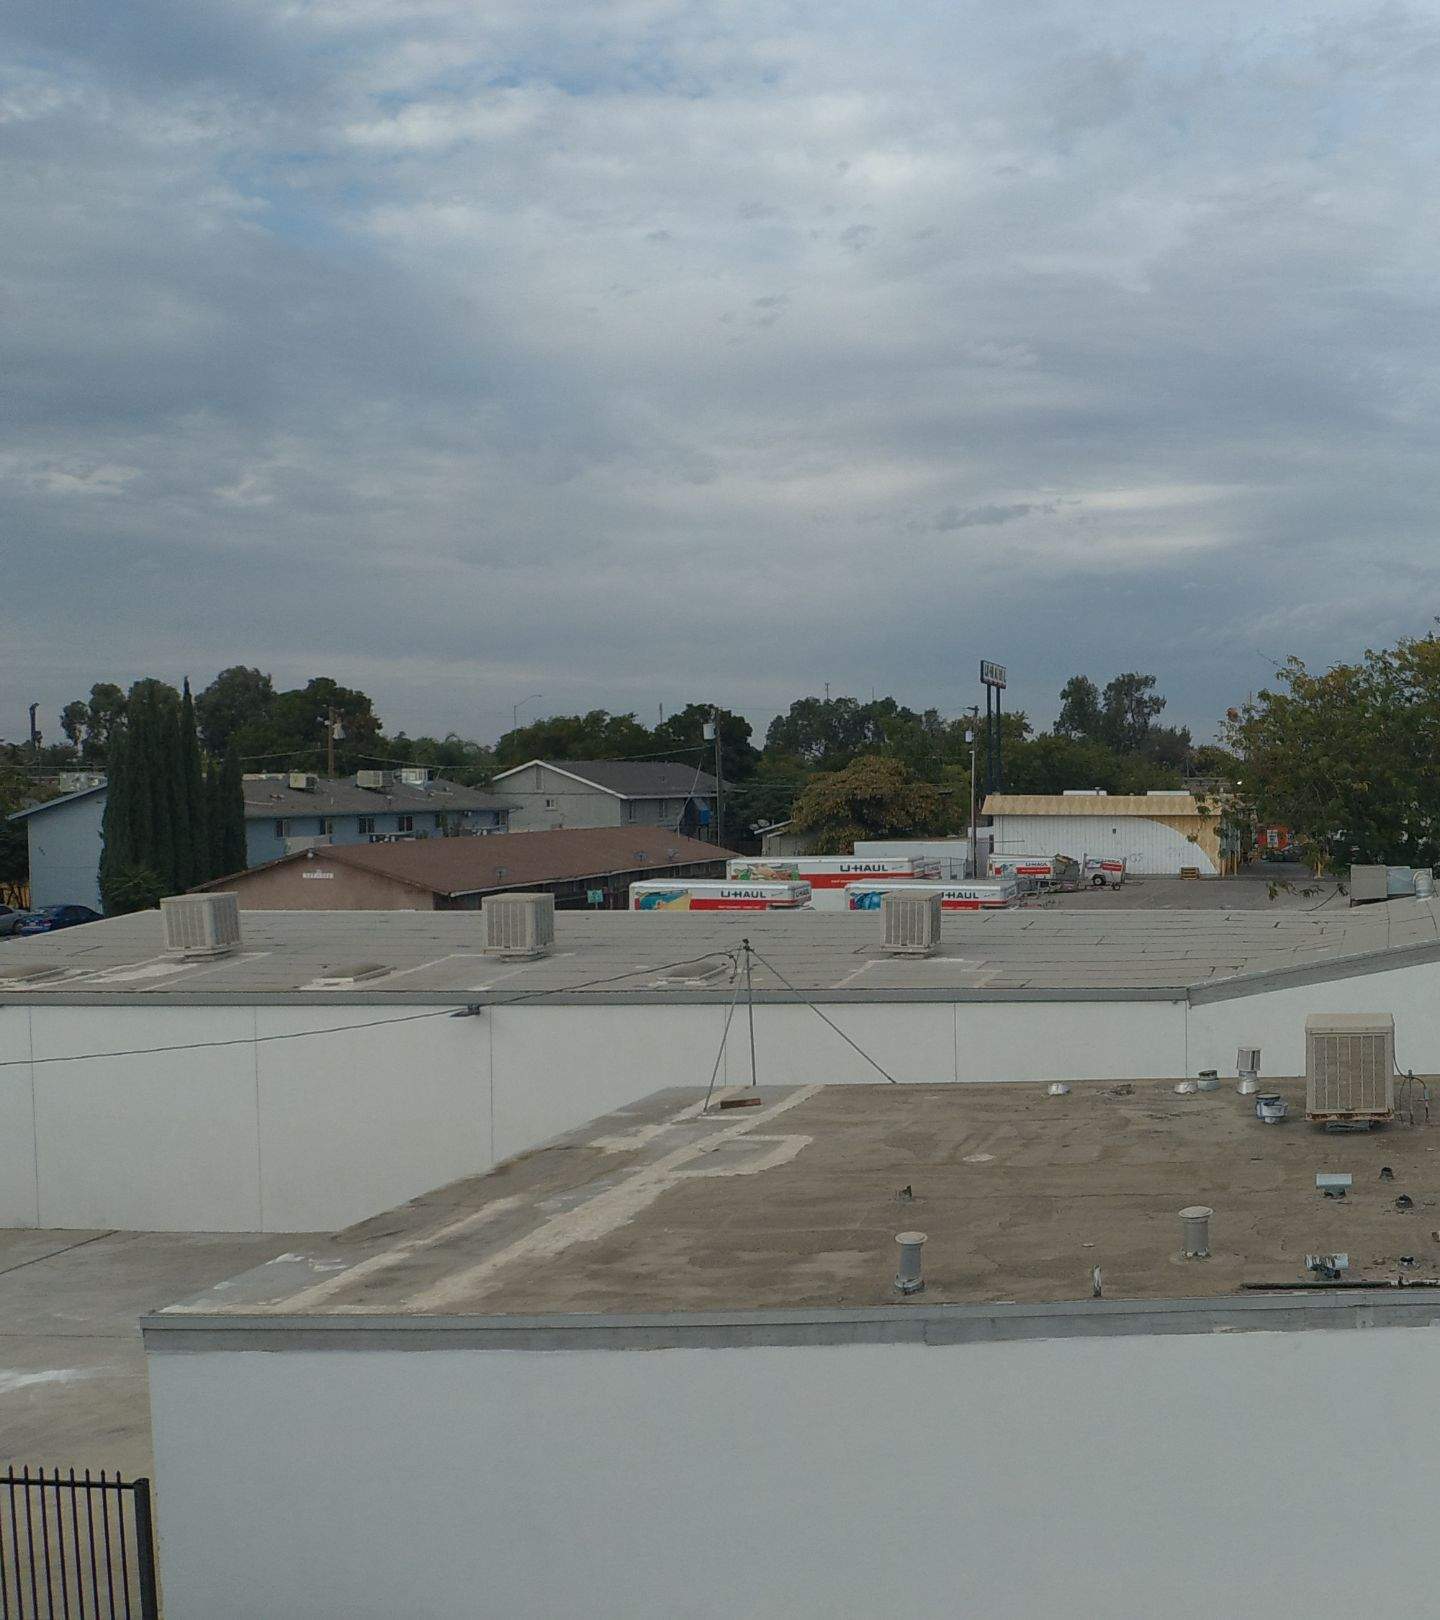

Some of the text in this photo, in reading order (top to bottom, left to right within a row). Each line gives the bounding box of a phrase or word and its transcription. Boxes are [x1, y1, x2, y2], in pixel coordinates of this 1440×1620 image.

[839, 864, 889, 872] U-HAUL
[720, 890, 767, 898] U-HAUL
[941, 891, 979, 899] -HAUL
